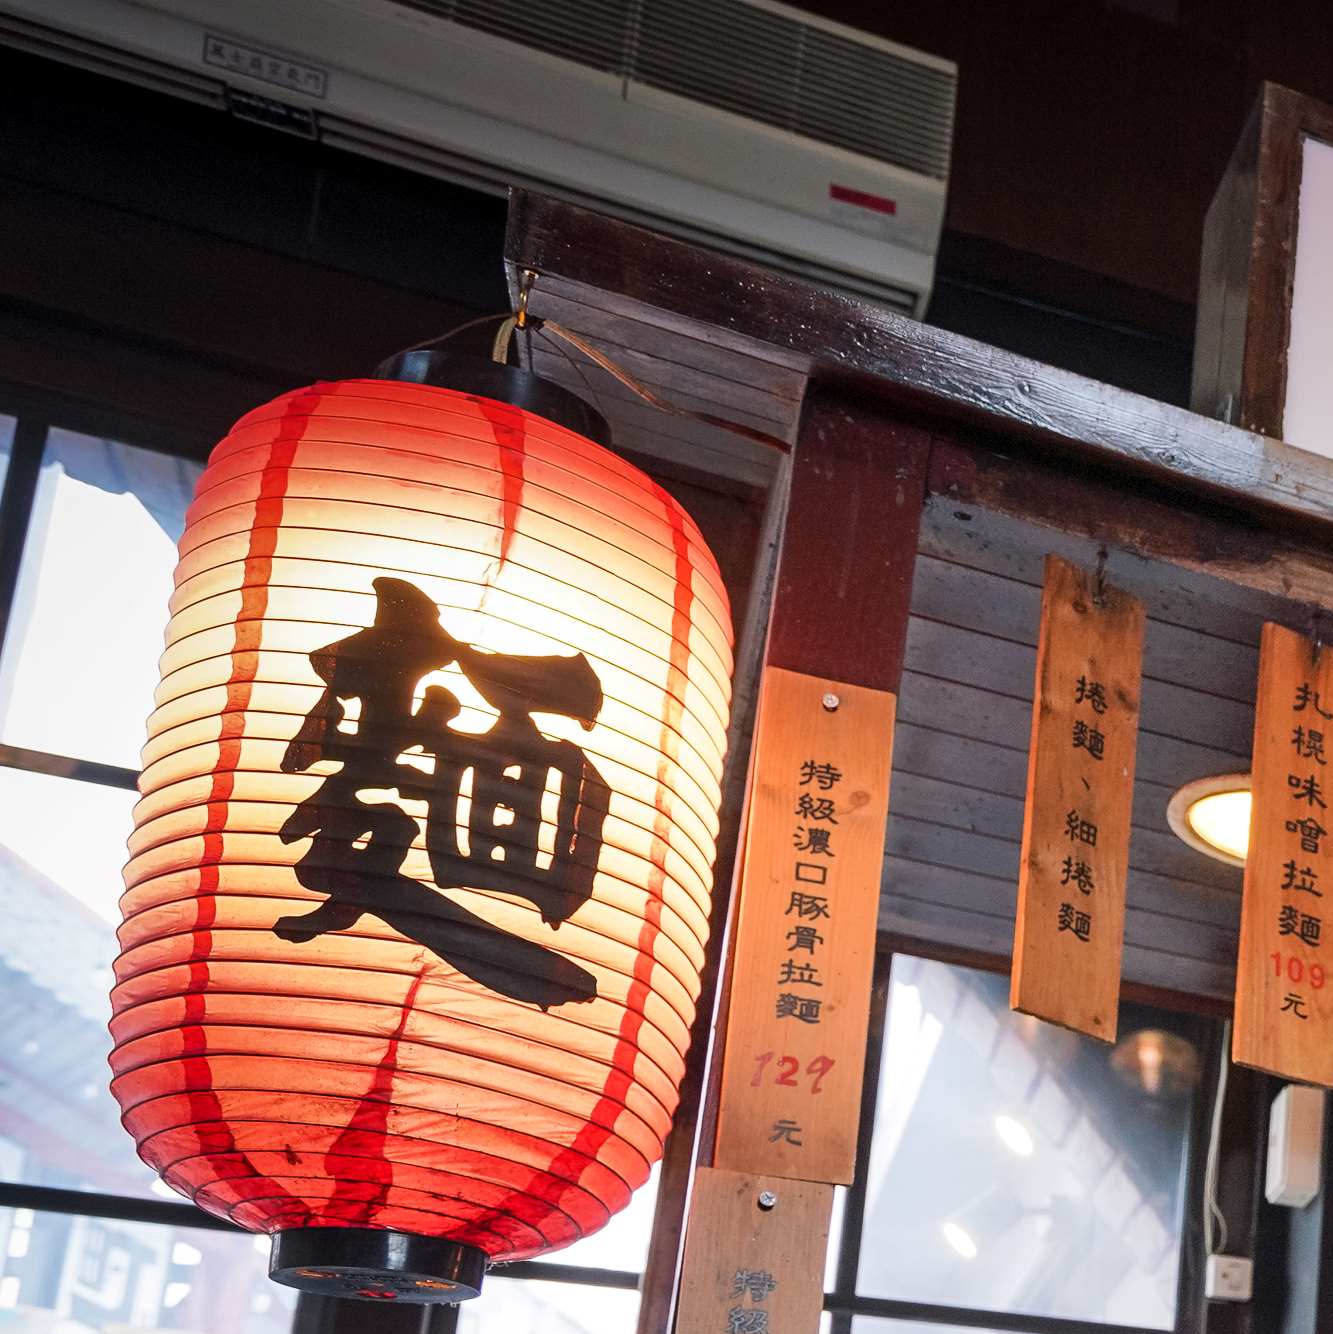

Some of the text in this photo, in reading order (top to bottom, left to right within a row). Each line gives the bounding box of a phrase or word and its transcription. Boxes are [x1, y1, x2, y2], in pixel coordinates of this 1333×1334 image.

[272, 576, 612, 1013] 麵
[1269, 950, 1329, 992] 109
[1280, 993, 1308, 1020] 元
[768, 1119, 804, 1147] 元
